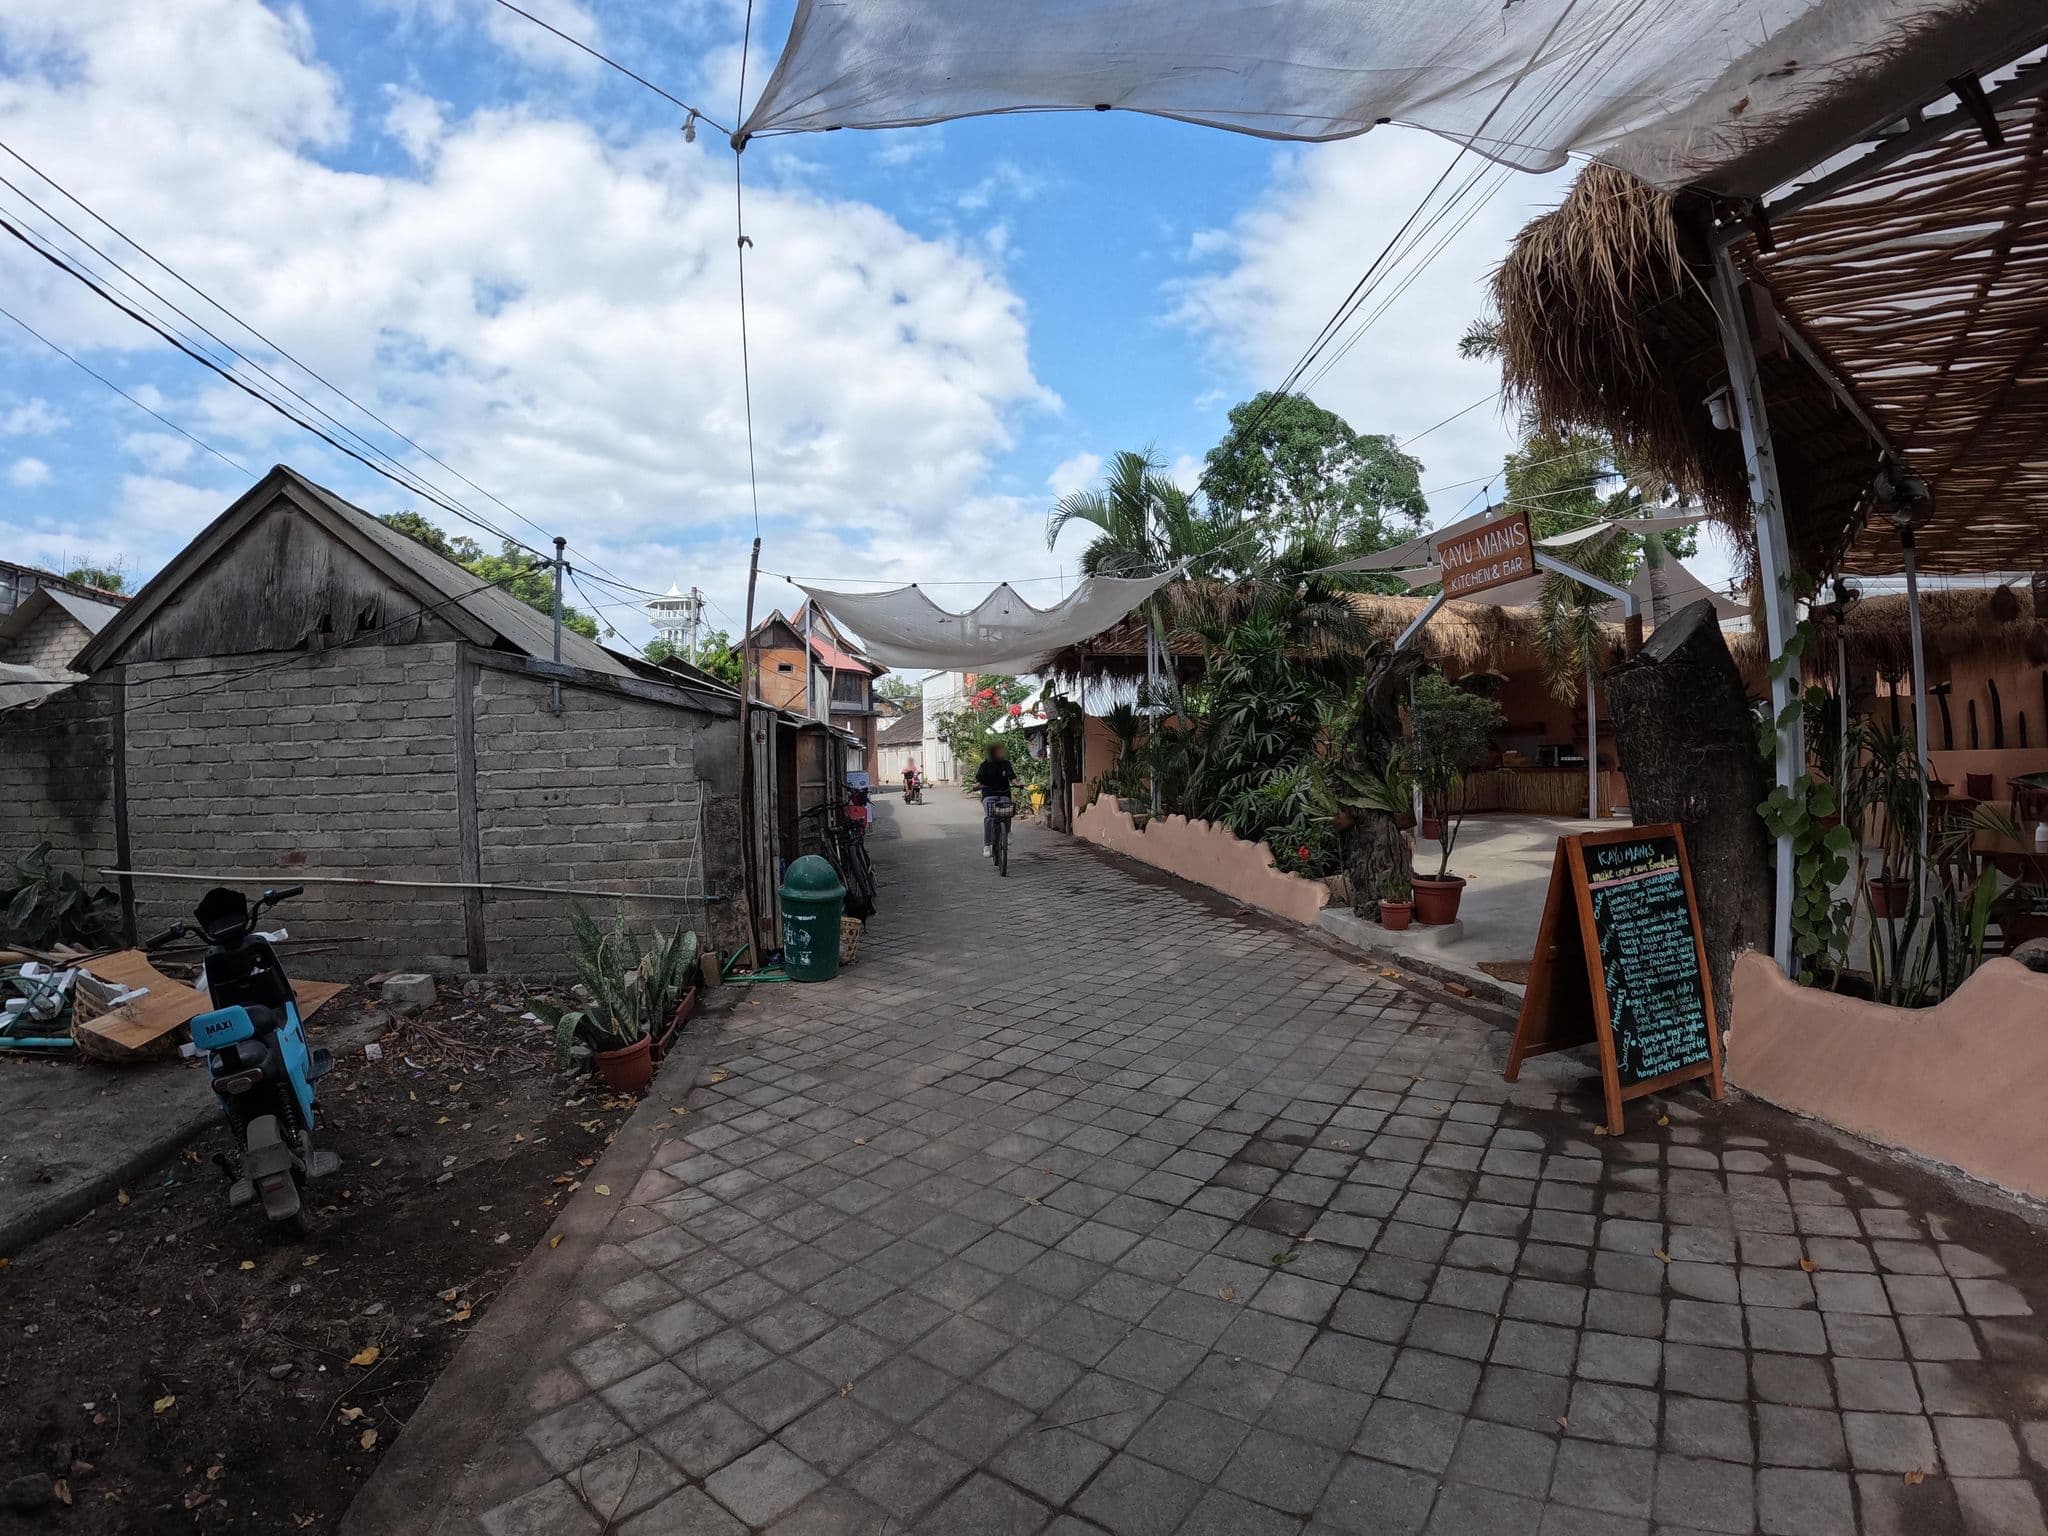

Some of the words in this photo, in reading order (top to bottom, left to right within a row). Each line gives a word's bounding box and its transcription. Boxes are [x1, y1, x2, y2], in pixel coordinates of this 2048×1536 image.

[1438, 541, 1473, 572] KAYU
[1476, 522, 1526, 559] MANIS
[1451, 568, 1491, 591] KITCHEN
[1491, 564, 1500, 579] &
[1502, 557, 1523, 576] BAR
[1597, 847, 1623, 866] KAYU
[1625, 844, 1655, 861] MANIS
[1592, 869, 1614, 882] make
[1616, 867, 1632, 879] your
[206, 1019, 233, 1034] MAXI
